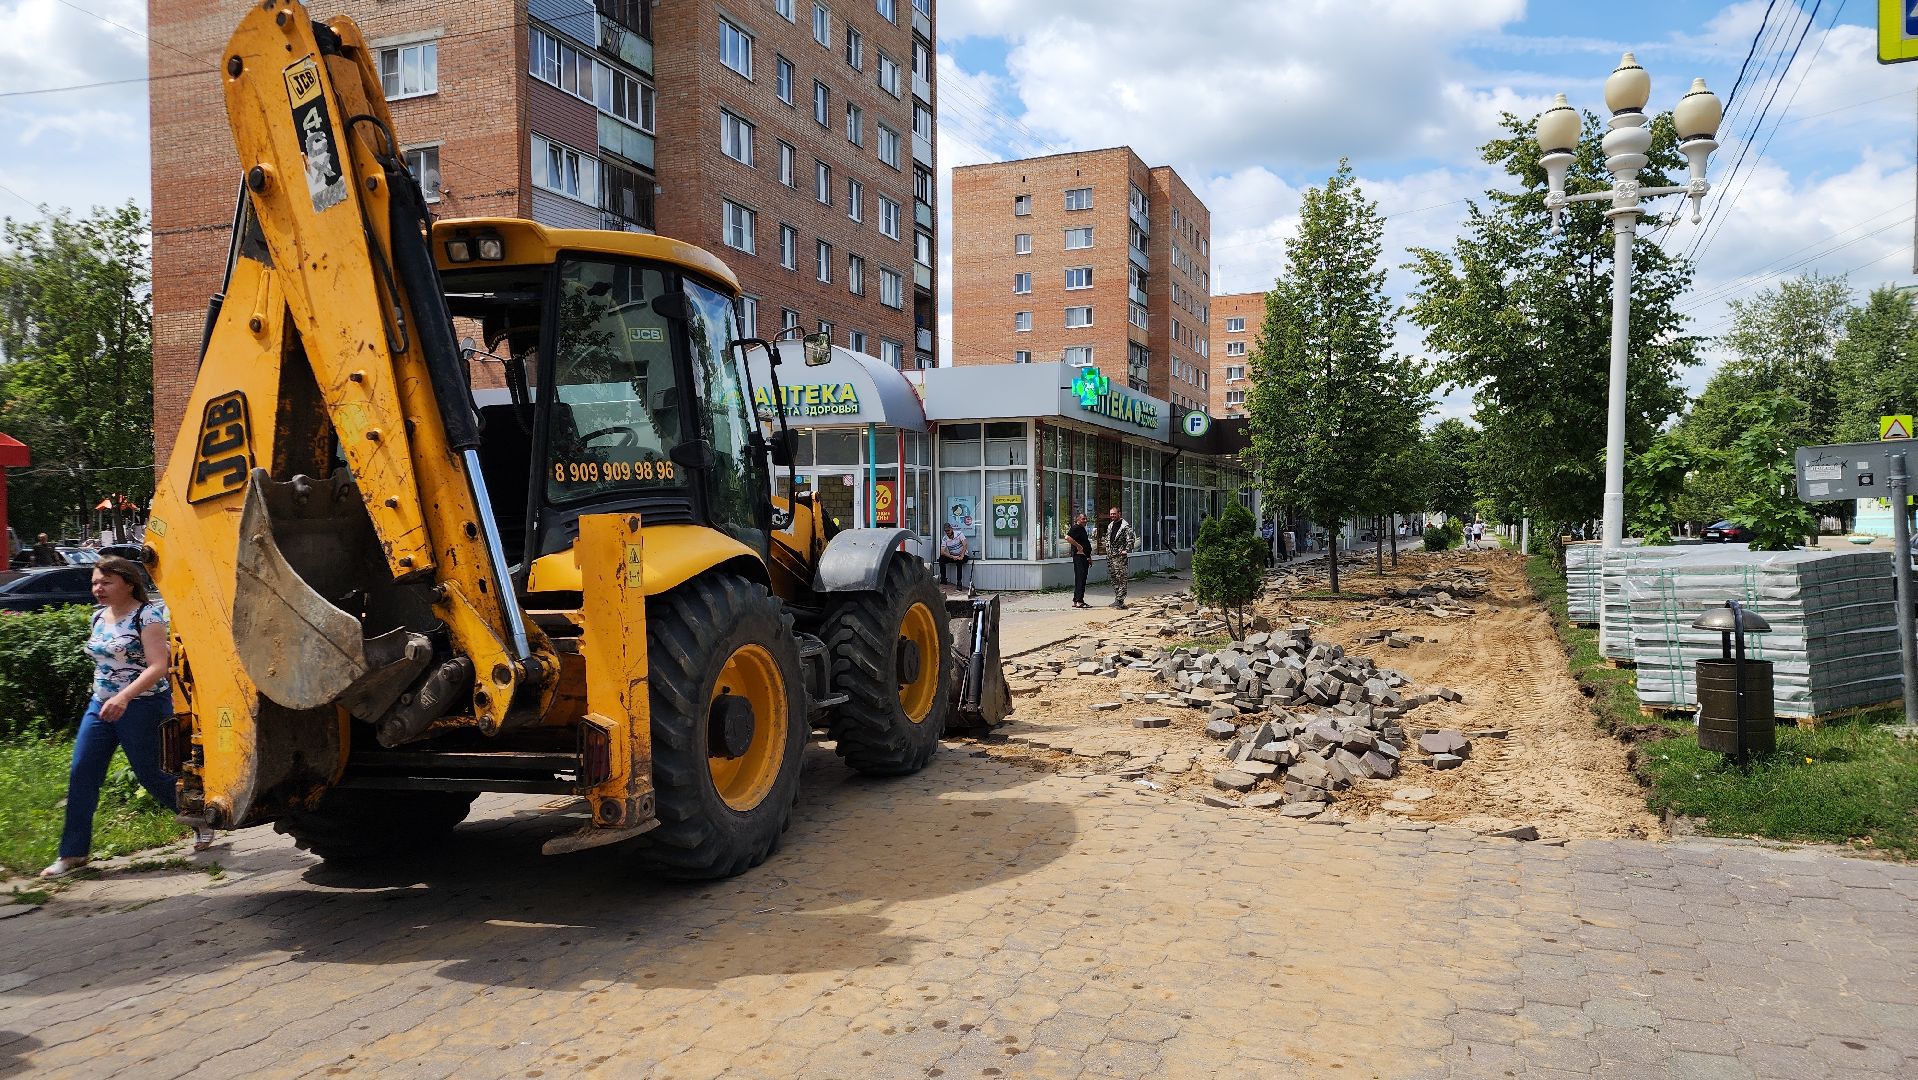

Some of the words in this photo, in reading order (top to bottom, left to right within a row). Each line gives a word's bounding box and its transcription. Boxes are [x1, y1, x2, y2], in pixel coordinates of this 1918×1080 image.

[293, 71, 315, 96] JCB
[631, 329, 661, 340] JCB
[804, 404, 859, 417] ЗДОРОВЬЯ
[1088, 390, 1133, 422] ПТЕКА
[1190, 418, 1202, 431] F
[195, 399, 248, 488] JCB
[555, 463, 565, 482] 8
[569, 462, 598, 482] 909
[602, 462, 631, 481] 909
[634, 461, 653, 480] 98
[655, 460, 674, 480] 96
